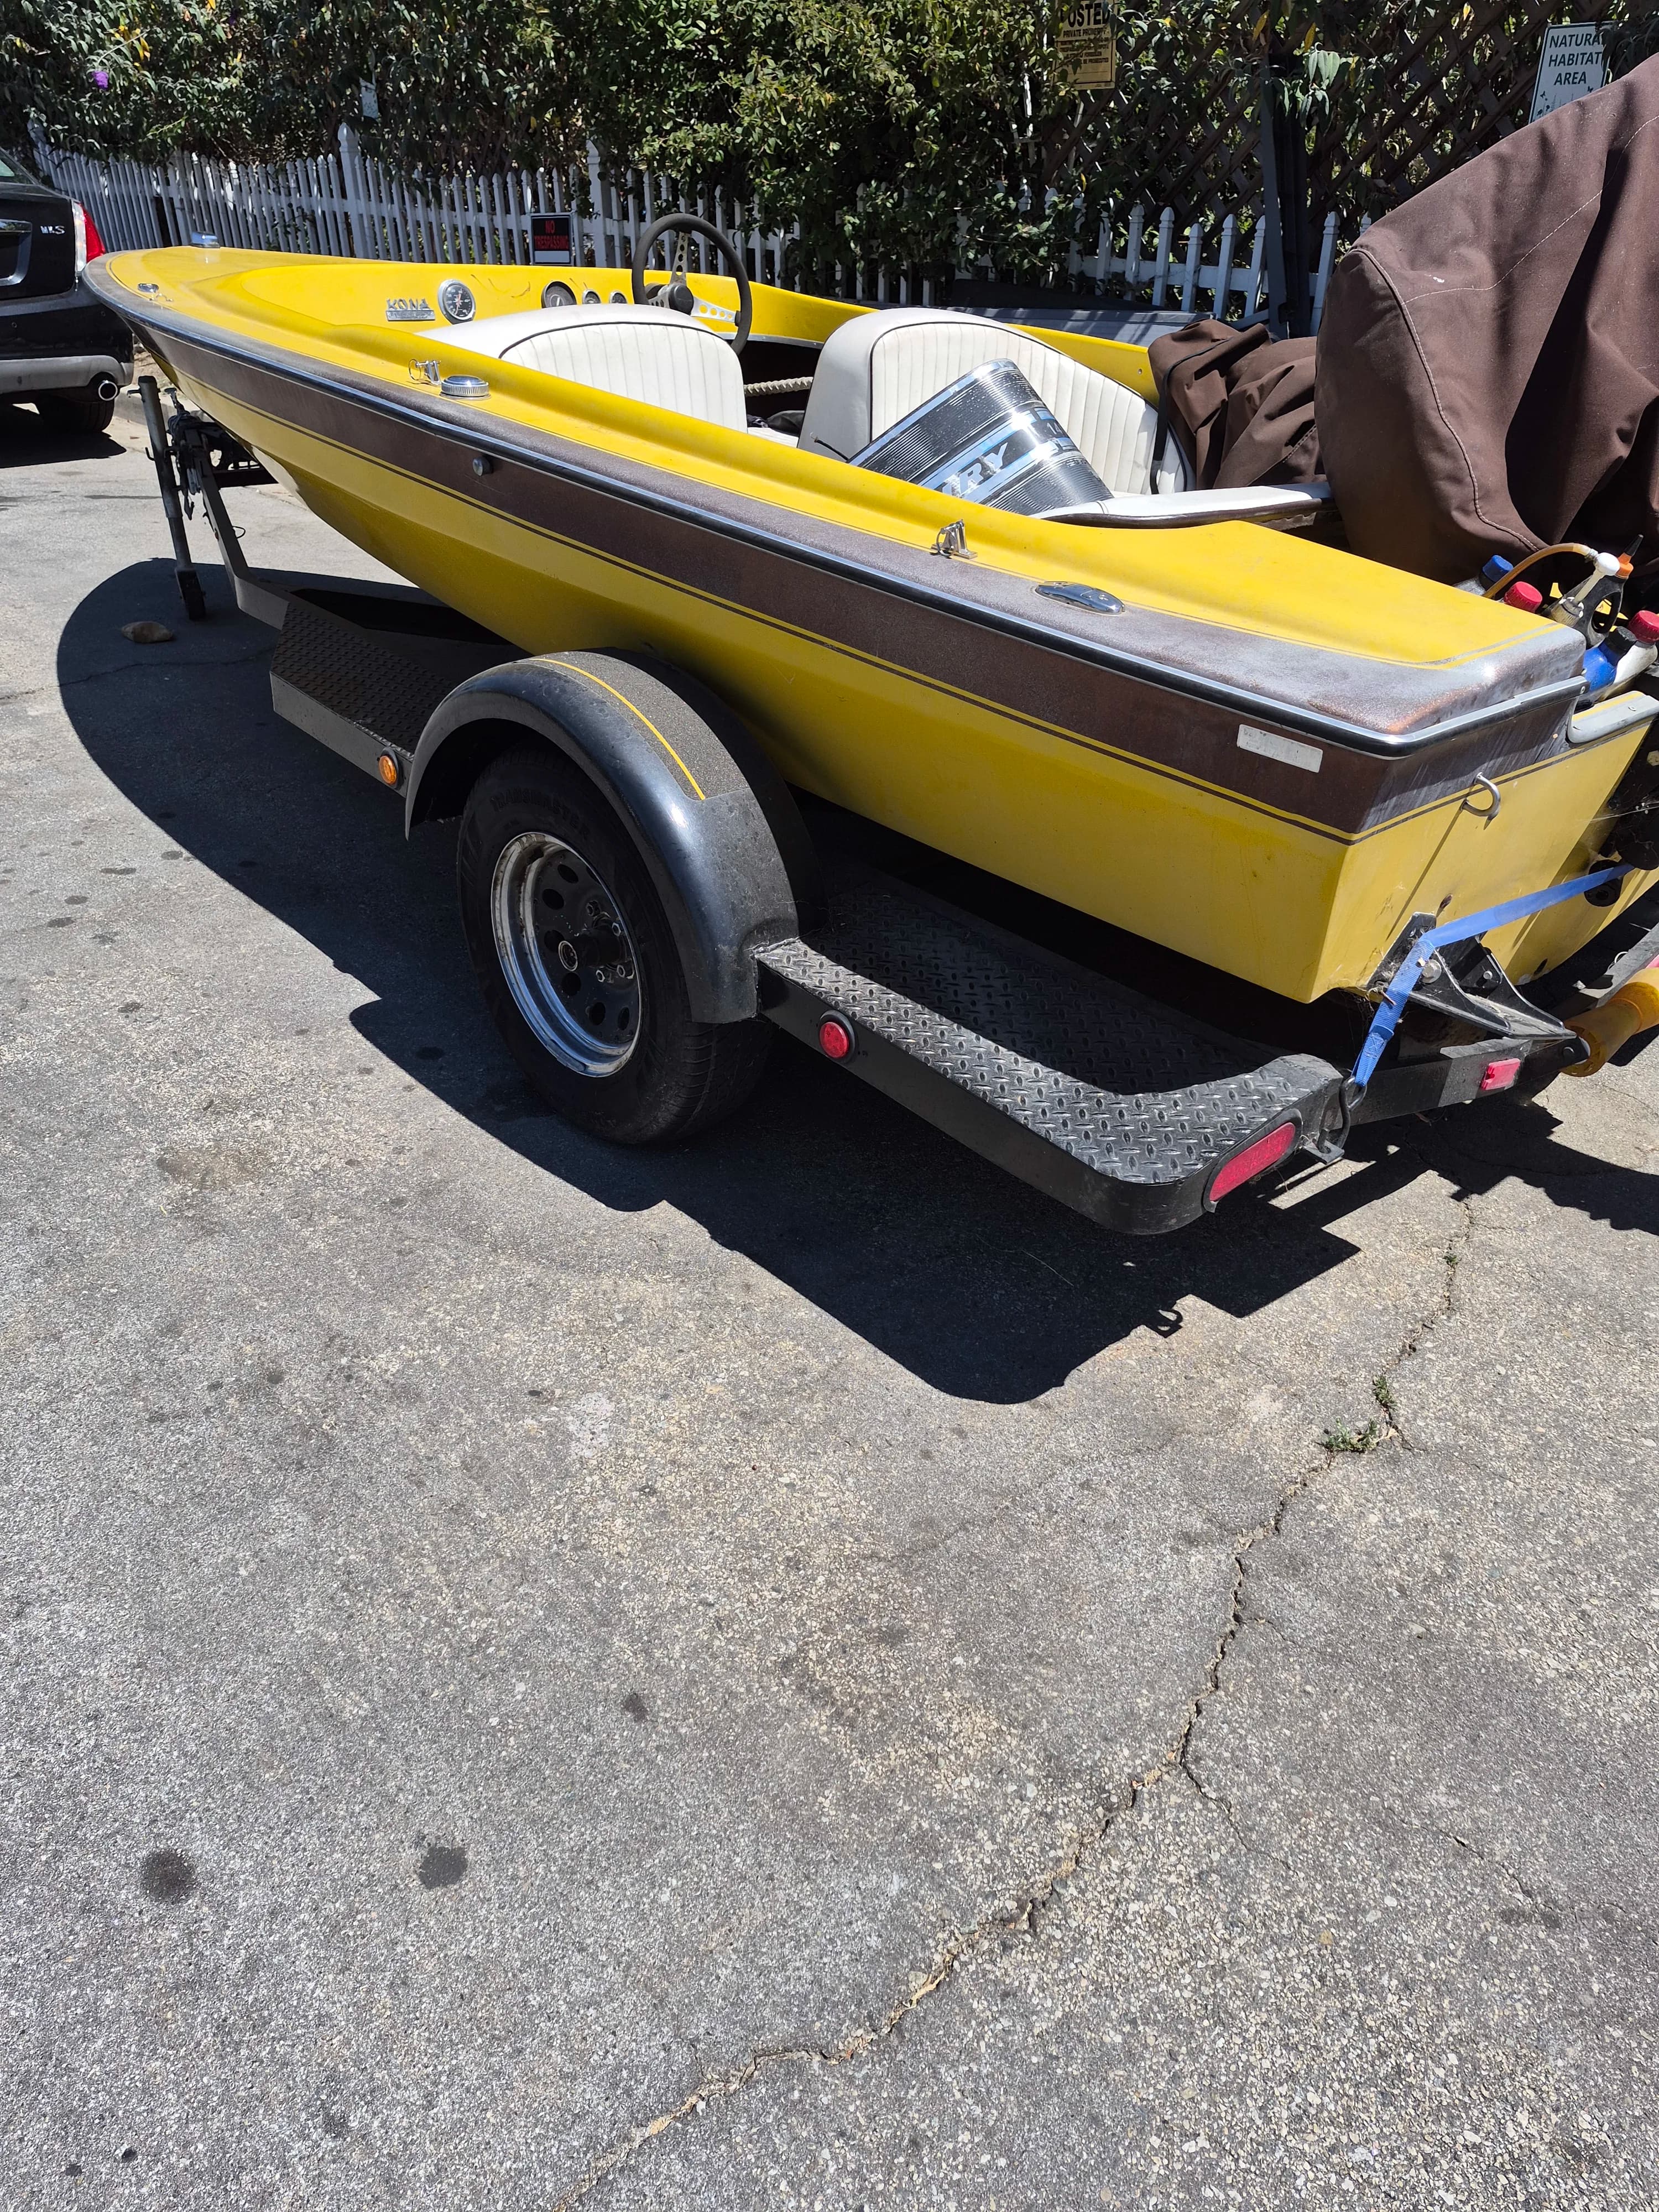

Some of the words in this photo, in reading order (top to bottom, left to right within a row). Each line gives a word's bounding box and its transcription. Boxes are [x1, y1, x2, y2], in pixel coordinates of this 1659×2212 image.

[1550, 33, 1600, 48] NATURA
[1548, 51, 1602, 67] HABITAT
[1553, 71, 1587, 85] AREA
[544, 220, 555, 233] NO
[387, 298, 430, 310] KONA
